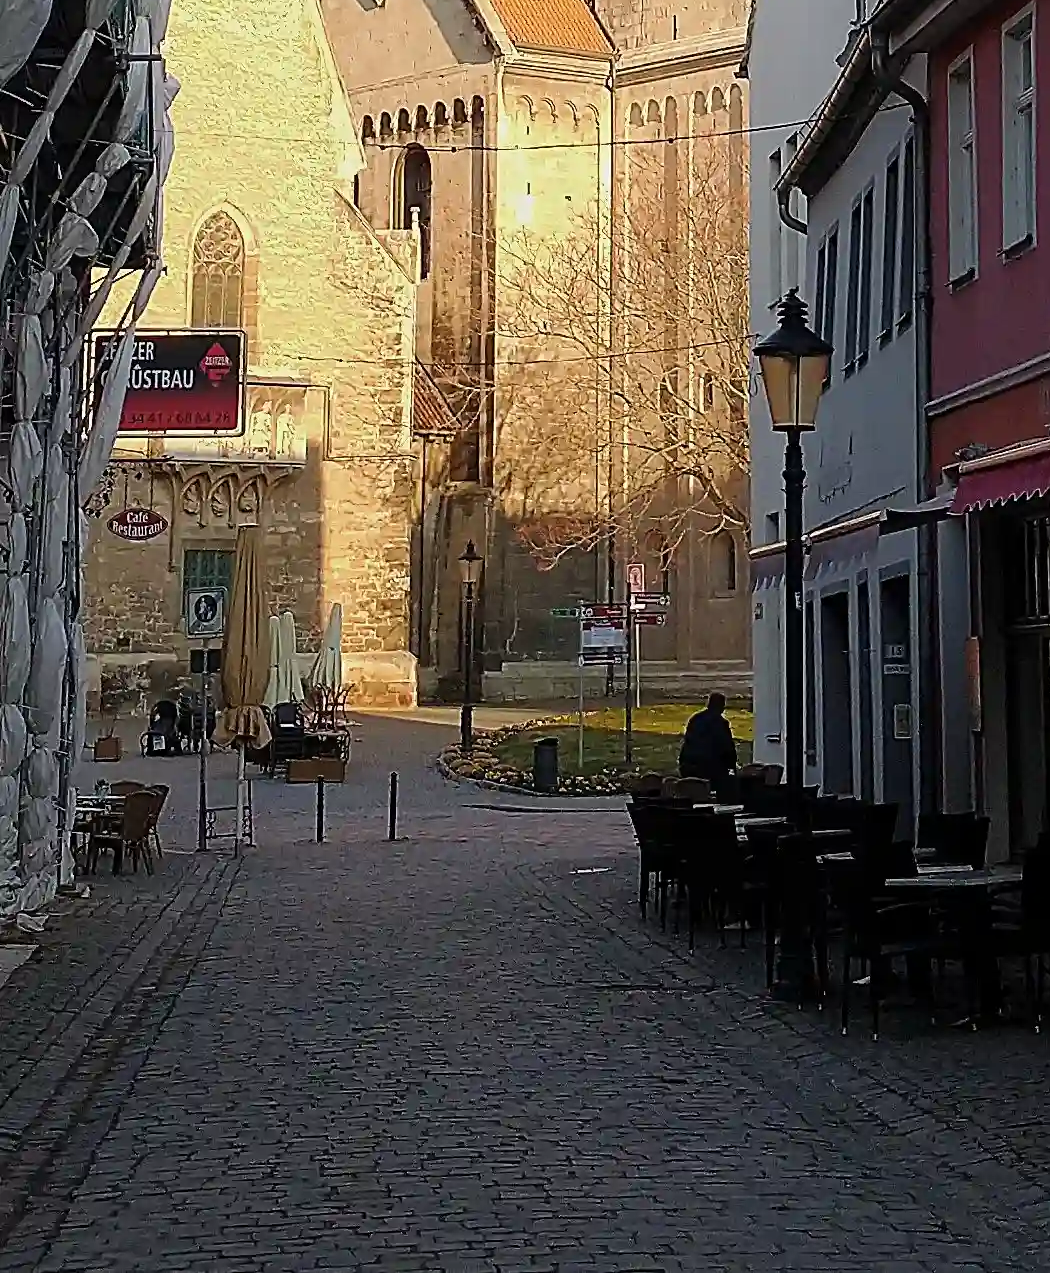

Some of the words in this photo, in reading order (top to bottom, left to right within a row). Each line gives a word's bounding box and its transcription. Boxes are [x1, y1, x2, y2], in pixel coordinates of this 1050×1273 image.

[101, 341, 154, 360] ZEZER
[101, 364, 194, 389] ÜSTBAU
[126, 511, 149, 524] Café
[112, 520, 163, 537] Restaurant
